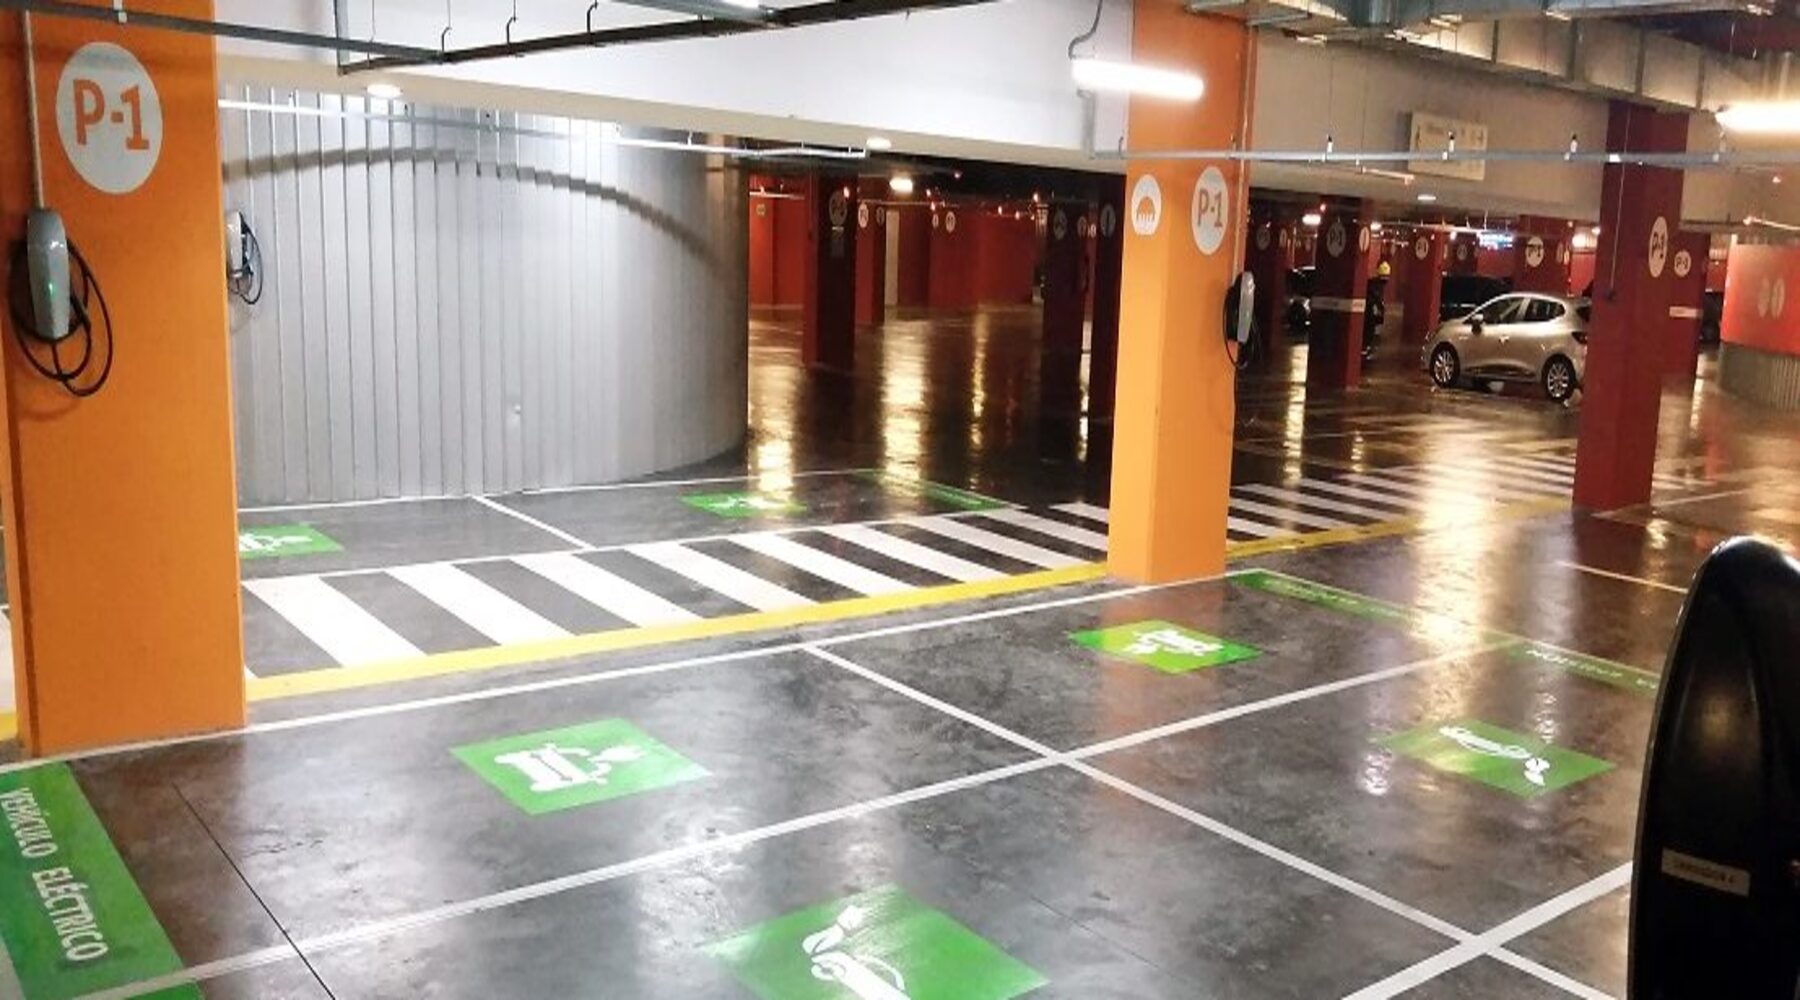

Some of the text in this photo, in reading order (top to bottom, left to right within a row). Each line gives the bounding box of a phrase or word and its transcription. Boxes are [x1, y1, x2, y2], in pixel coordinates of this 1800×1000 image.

[73, 79, 150, 150] P-1
[1197, 188, 1223, 228] P-1
[0, 787, 109, 961] VEHÍCULO ELÉCTRICO
